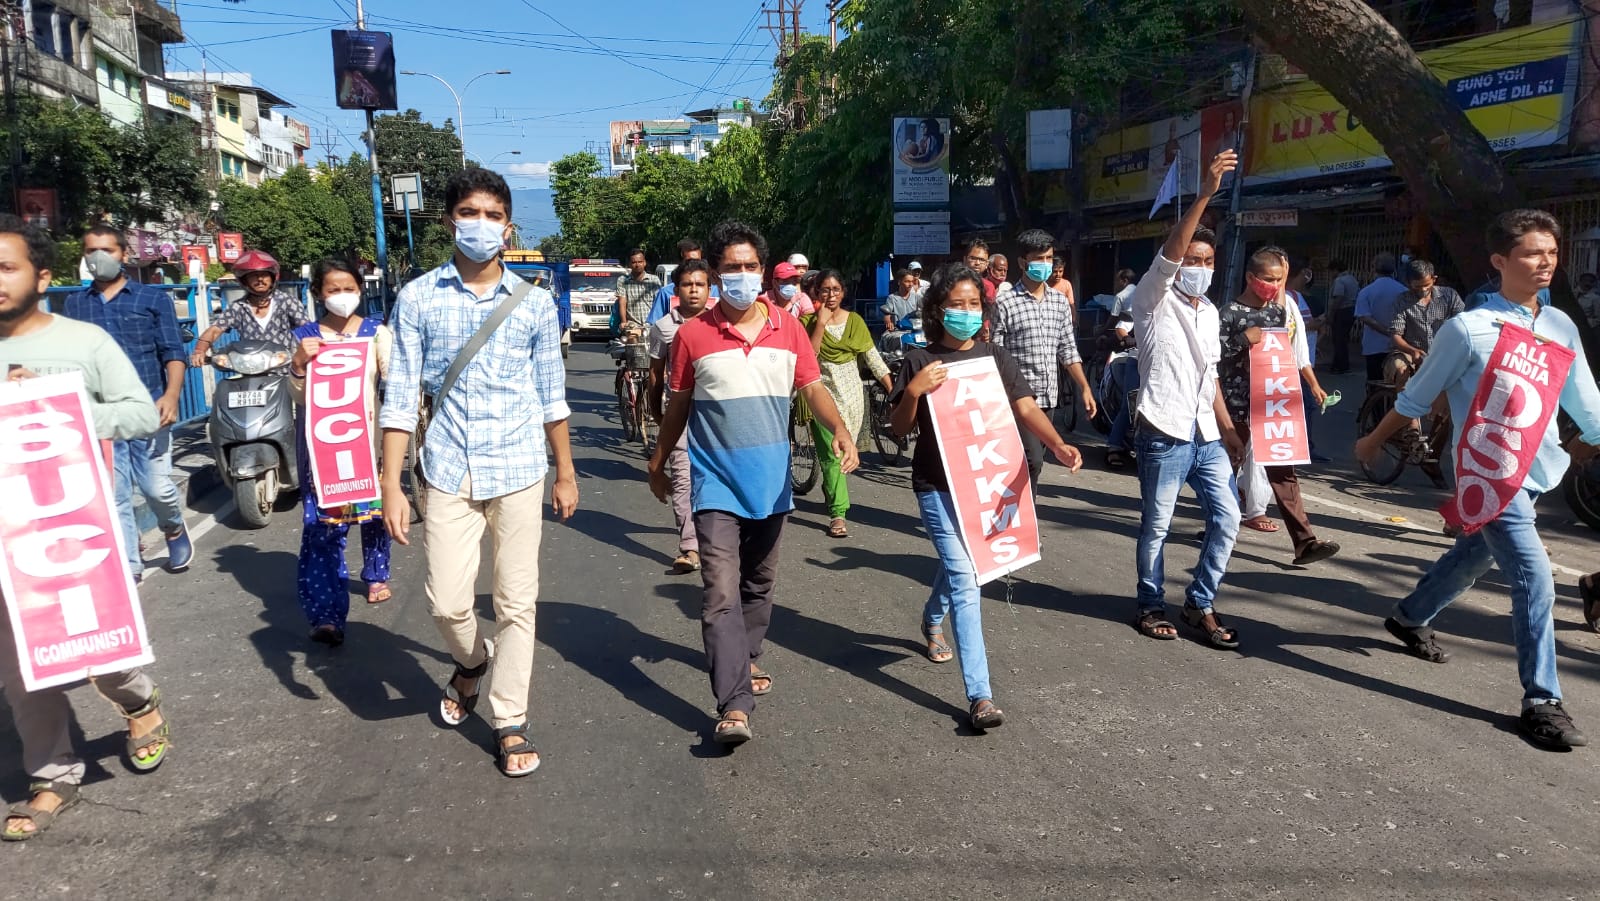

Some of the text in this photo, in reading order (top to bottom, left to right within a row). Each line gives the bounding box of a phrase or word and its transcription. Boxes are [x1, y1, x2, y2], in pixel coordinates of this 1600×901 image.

[1456, 67, 1526, 92] SUNO TOH
[1470, 79, 1554, 107] APNE DIL KI
[1272, 112, 1339, 144] LUX
[1336, 160, 1366, 171] DRESSES
[1501, 352, 1549, 386] INDIA
[1514, 342, 1549, 369] ALL
[1262, 333, 1295, 460] AIKKMS
[313, 348, 364, 480] SUCI
[1457, 368, 1543, 525] DSO
[323, 478, 373, 496] (COMMUNIST)
[953, 376, 1021, 565] AIKKMS
[0, 410, 111, 637] SUCI
[34, 625, 134, 667] (COMMUNIST)
